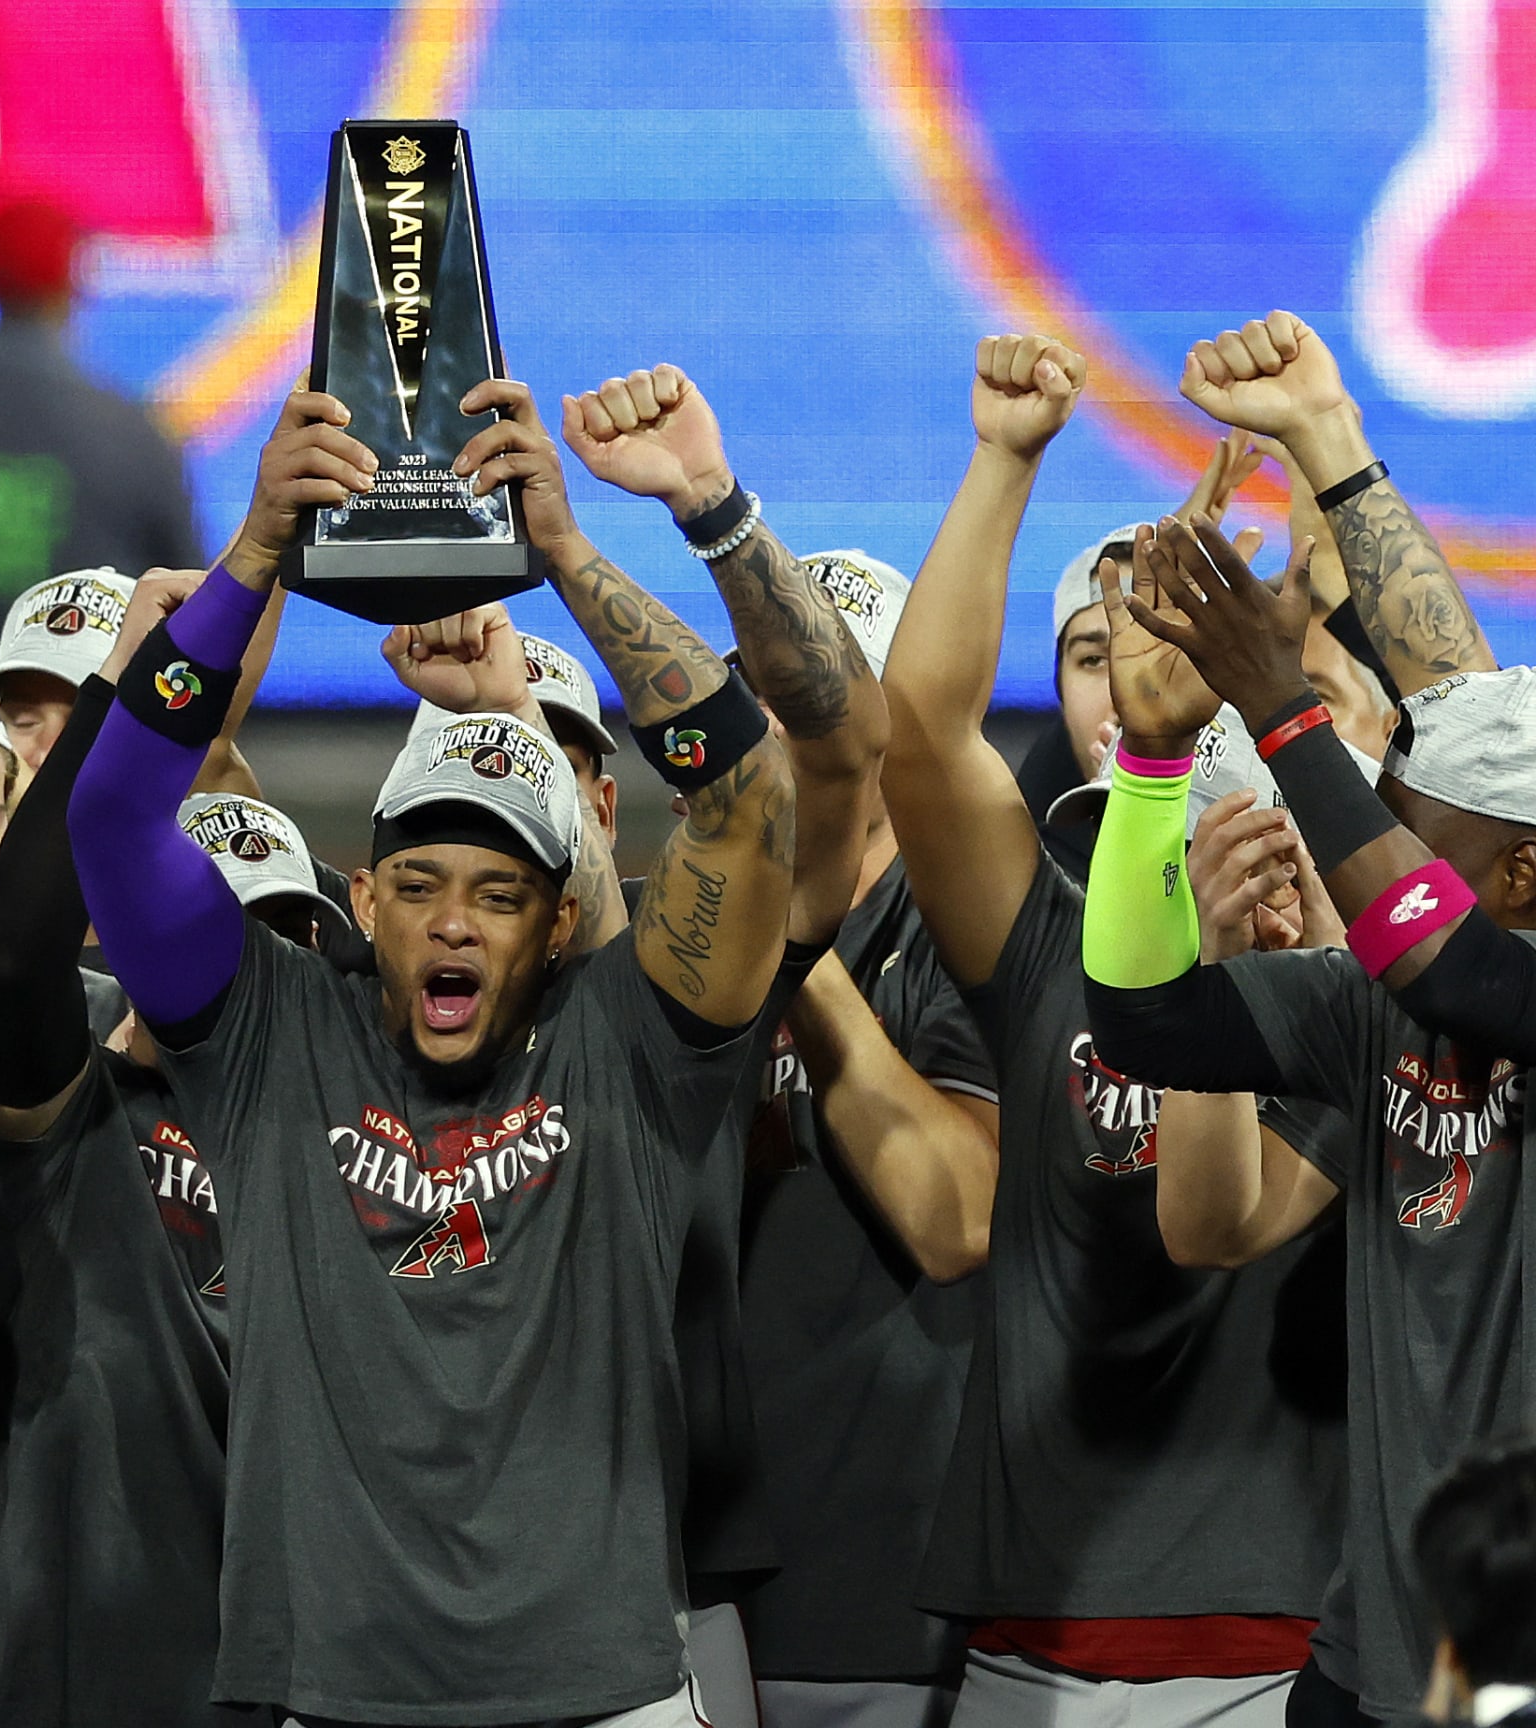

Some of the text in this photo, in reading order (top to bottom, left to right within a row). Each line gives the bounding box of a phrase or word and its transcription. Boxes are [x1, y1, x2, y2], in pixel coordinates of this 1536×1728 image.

[385, 181, 424, 346] NATIONAL
[372, 469, 457, 481] TIONAL LEAG
[398, 455, 427, 466] 2023
[343, 497, 485, 510] MOST VALUABLE PLAYER
[76, 585, 128, 633] SERIE
[826, 566, 885, 638] SERIES
[426, 725, 556, 813] WORLD SERIES
[327, 1104, 571, 1214] CHAMPIONS
